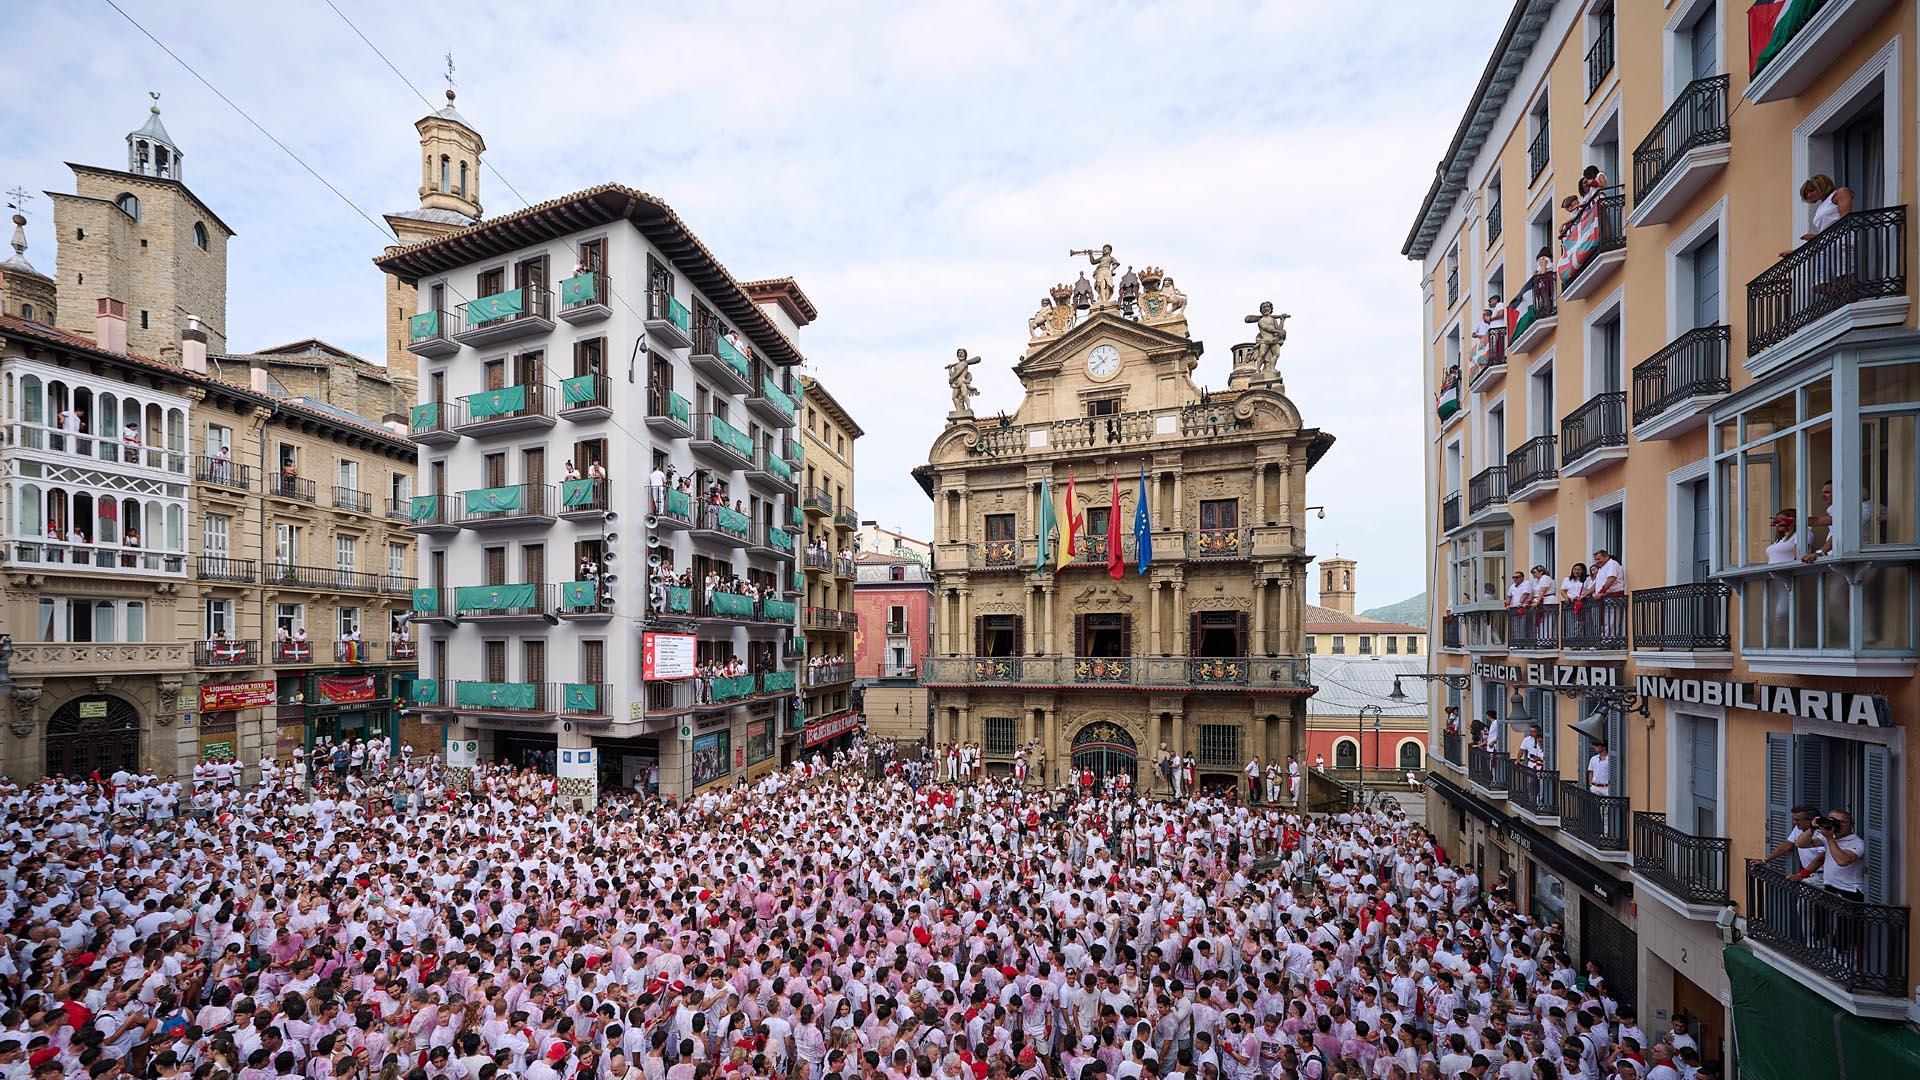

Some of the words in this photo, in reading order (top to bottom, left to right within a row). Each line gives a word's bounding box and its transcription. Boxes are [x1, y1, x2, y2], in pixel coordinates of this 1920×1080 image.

[647, 652, 652, 665] 6
[209, 683, 249, 692] LIQUIDACIÓN
[1471, 663, 1518, 681] AGENCIA
[1527, 664, 1616, 686] ELIZARI
[1636, 676, 1880, 727] INMOBILIARIA
[1681, 948, 1687, 963] 2
